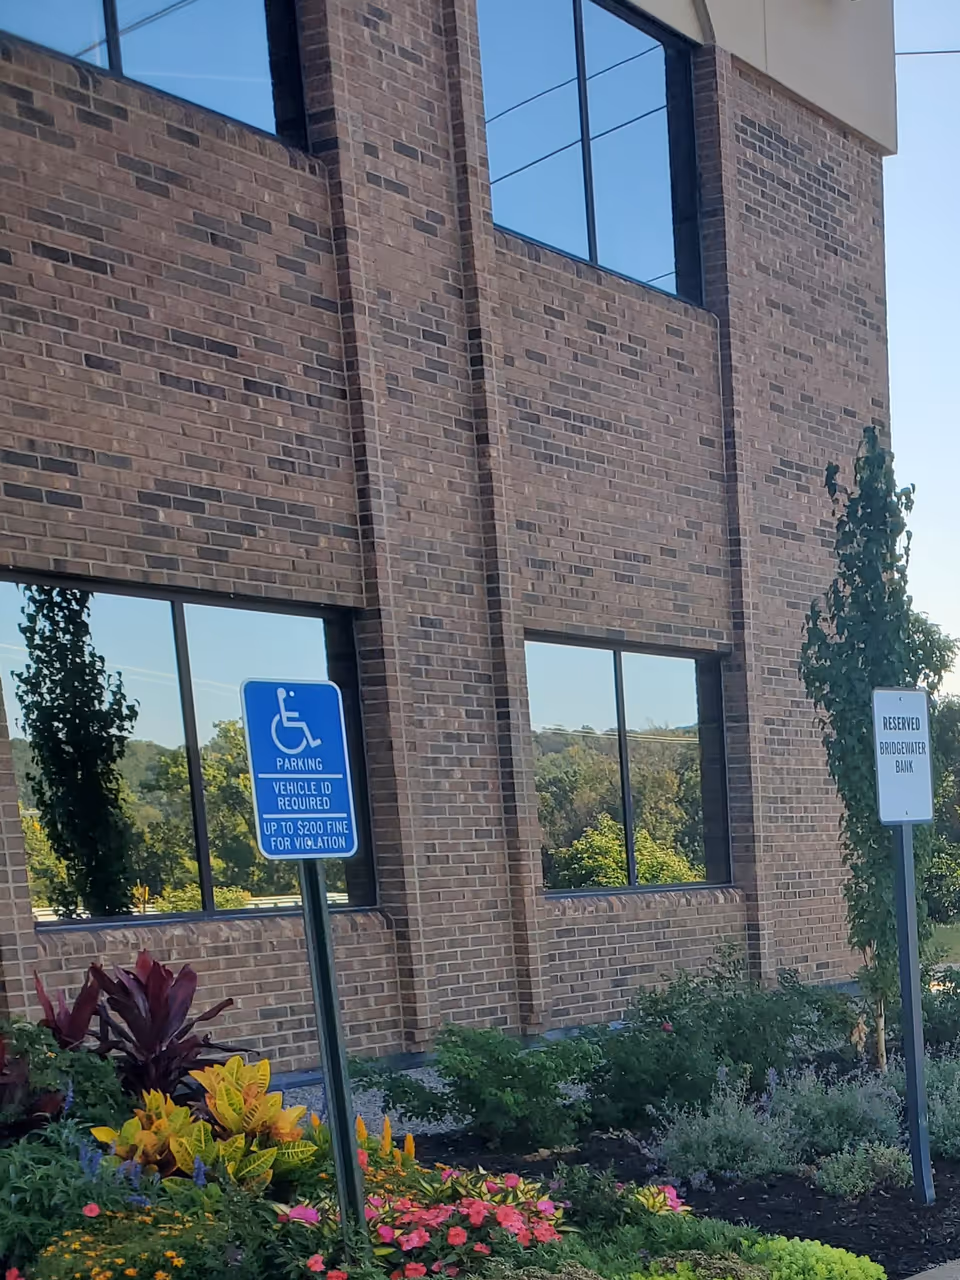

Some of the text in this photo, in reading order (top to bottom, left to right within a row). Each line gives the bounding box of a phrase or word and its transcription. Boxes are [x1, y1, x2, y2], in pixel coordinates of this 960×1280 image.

[883, 716, 921, 731] RESERVED
[880, 741, 927, 755] BRIDGEWATER
[276, 757, 323, 770] PARKING
[895, 760, 914, 773] BANK
[273, 781, 332, 794] VEHICLE ID
[278, 797, 330, 810] REQUIRED
[263, 821, 349, 835] UP TO $200 FINE
[271, 836, 346, 850] FOR VIOLATION
